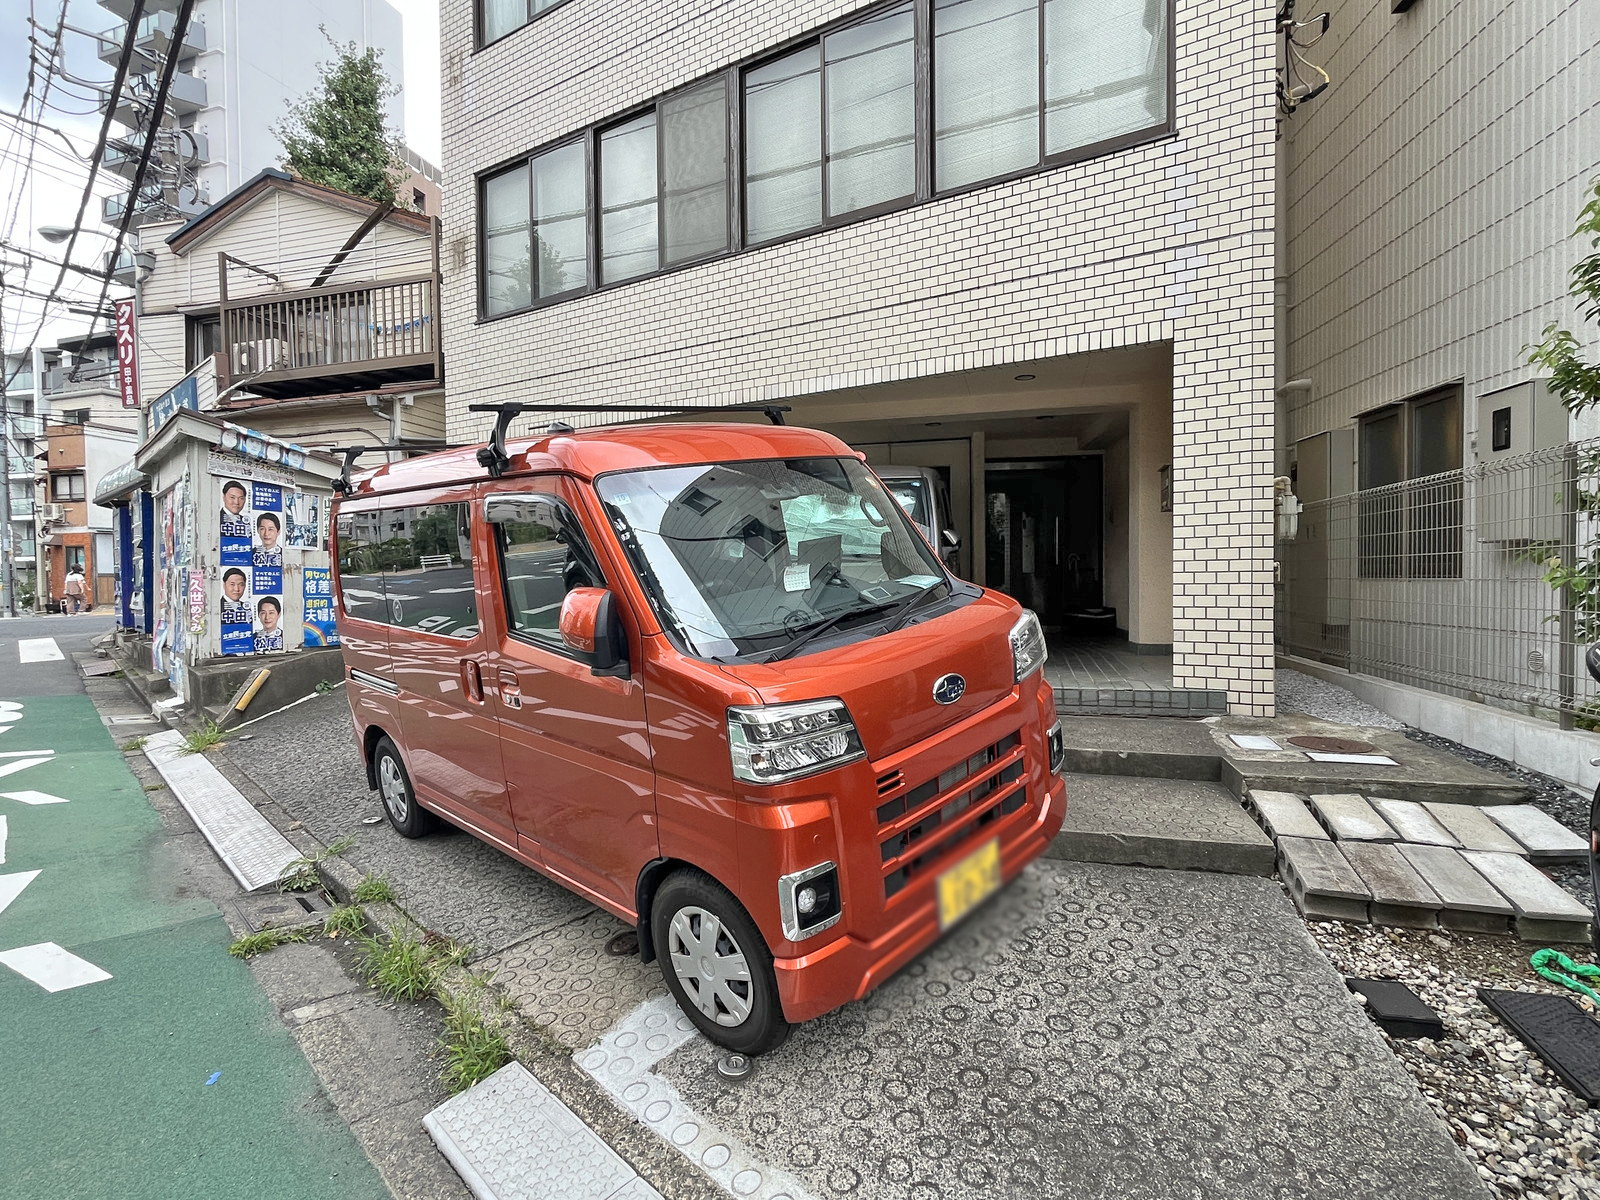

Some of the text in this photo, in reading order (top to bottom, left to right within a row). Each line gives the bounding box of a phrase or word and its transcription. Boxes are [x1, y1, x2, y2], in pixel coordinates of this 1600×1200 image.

[118, 304, 133, 365] クスリ
[221, 523, 246, 536] 中田
[253, 554, 277, 567] 松尾
[305, 580, 330, 594] 格差
[190, 578, 204, 632] 久世めぐみ
[222, 611, 246, 623] 中田
[254, 637, 277, 651] 松尾
